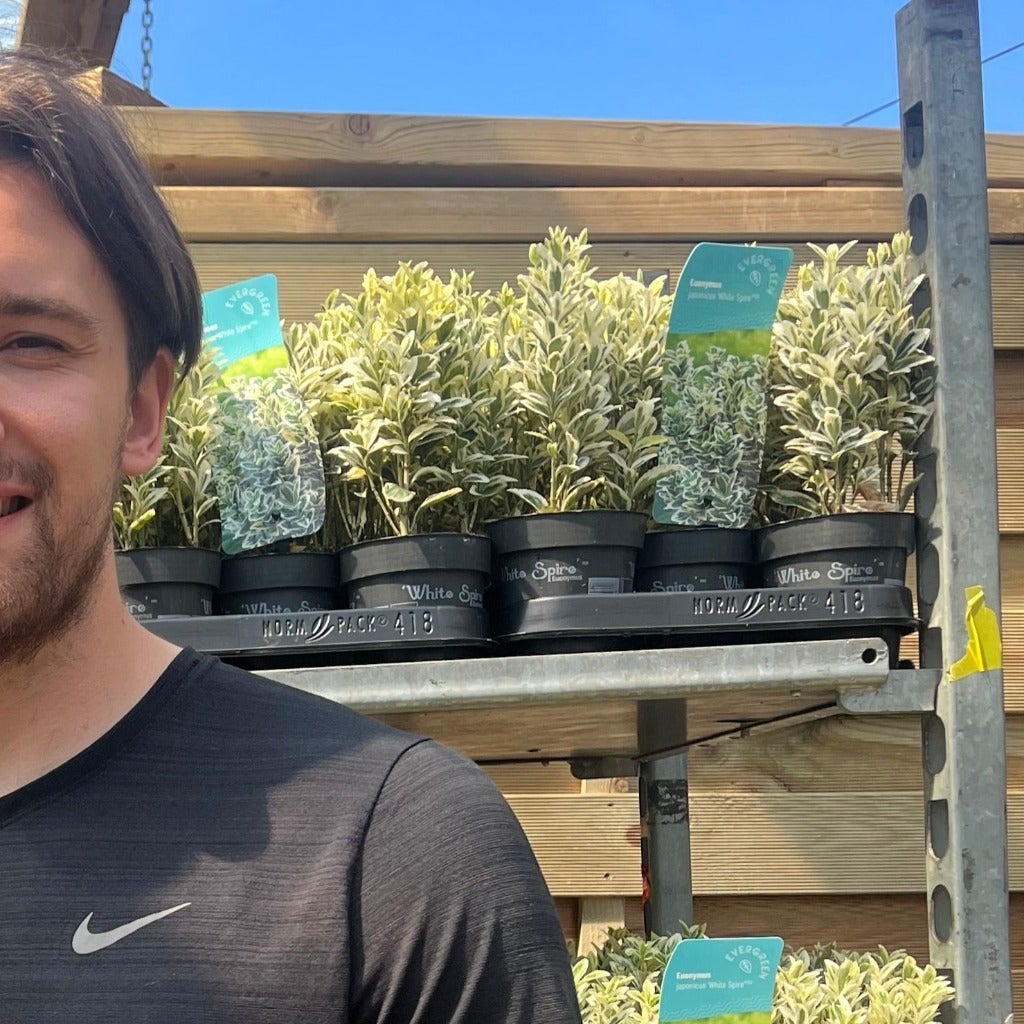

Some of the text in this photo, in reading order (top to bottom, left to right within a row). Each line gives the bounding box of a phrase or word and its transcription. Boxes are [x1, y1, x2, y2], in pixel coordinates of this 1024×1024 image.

[737, 254, 778, 295] EVERGREEN
[225, 288, 271, 317] EVERGREEN
[693, 596, 738, 615] NORM
[825, 588, 865, 615] 418
[262, 618, 308, 638] NORM
[394, 610, 434, 636] 418
[725, 945, 770, 980] EVERGREEN
